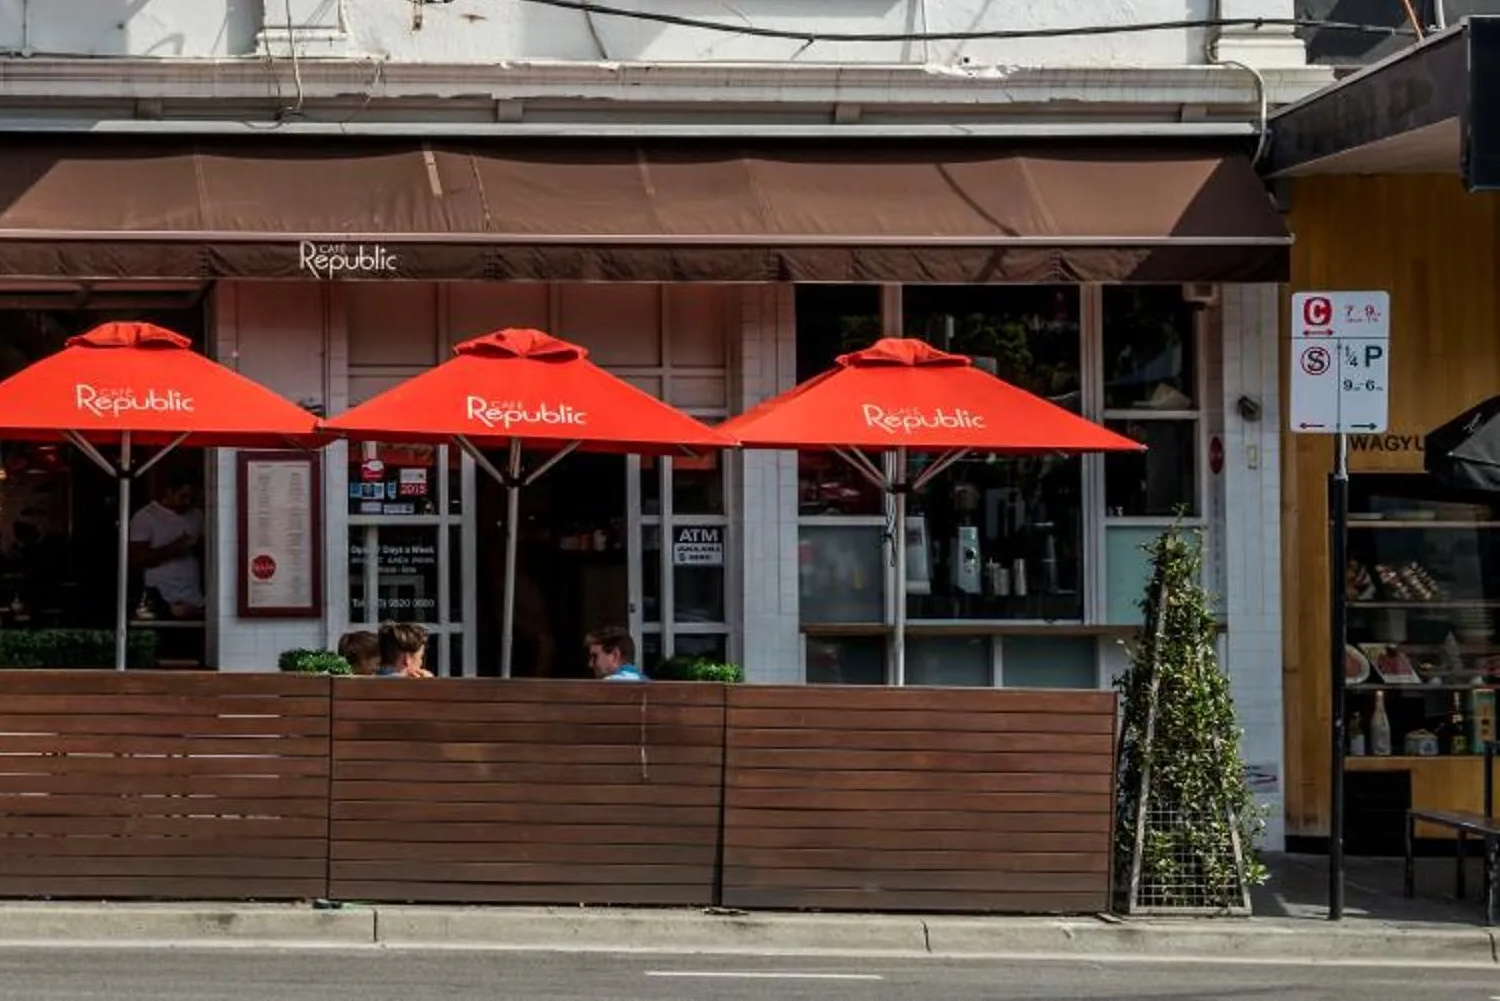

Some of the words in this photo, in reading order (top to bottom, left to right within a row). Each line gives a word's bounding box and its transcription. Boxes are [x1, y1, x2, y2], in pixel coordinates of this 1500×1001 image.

[299, 240, 397, 280] Republic
[1308, 300, 1328, 323] C
[1307, 350, 1325, 371] S
[1365, 345, 1383, 368] P
[75, 383, 196, 418] Republic
[467, 395, 588, 429] Republic
[861, 403, 988, 435] Republic
[679, 528, 719, 542] ATM
